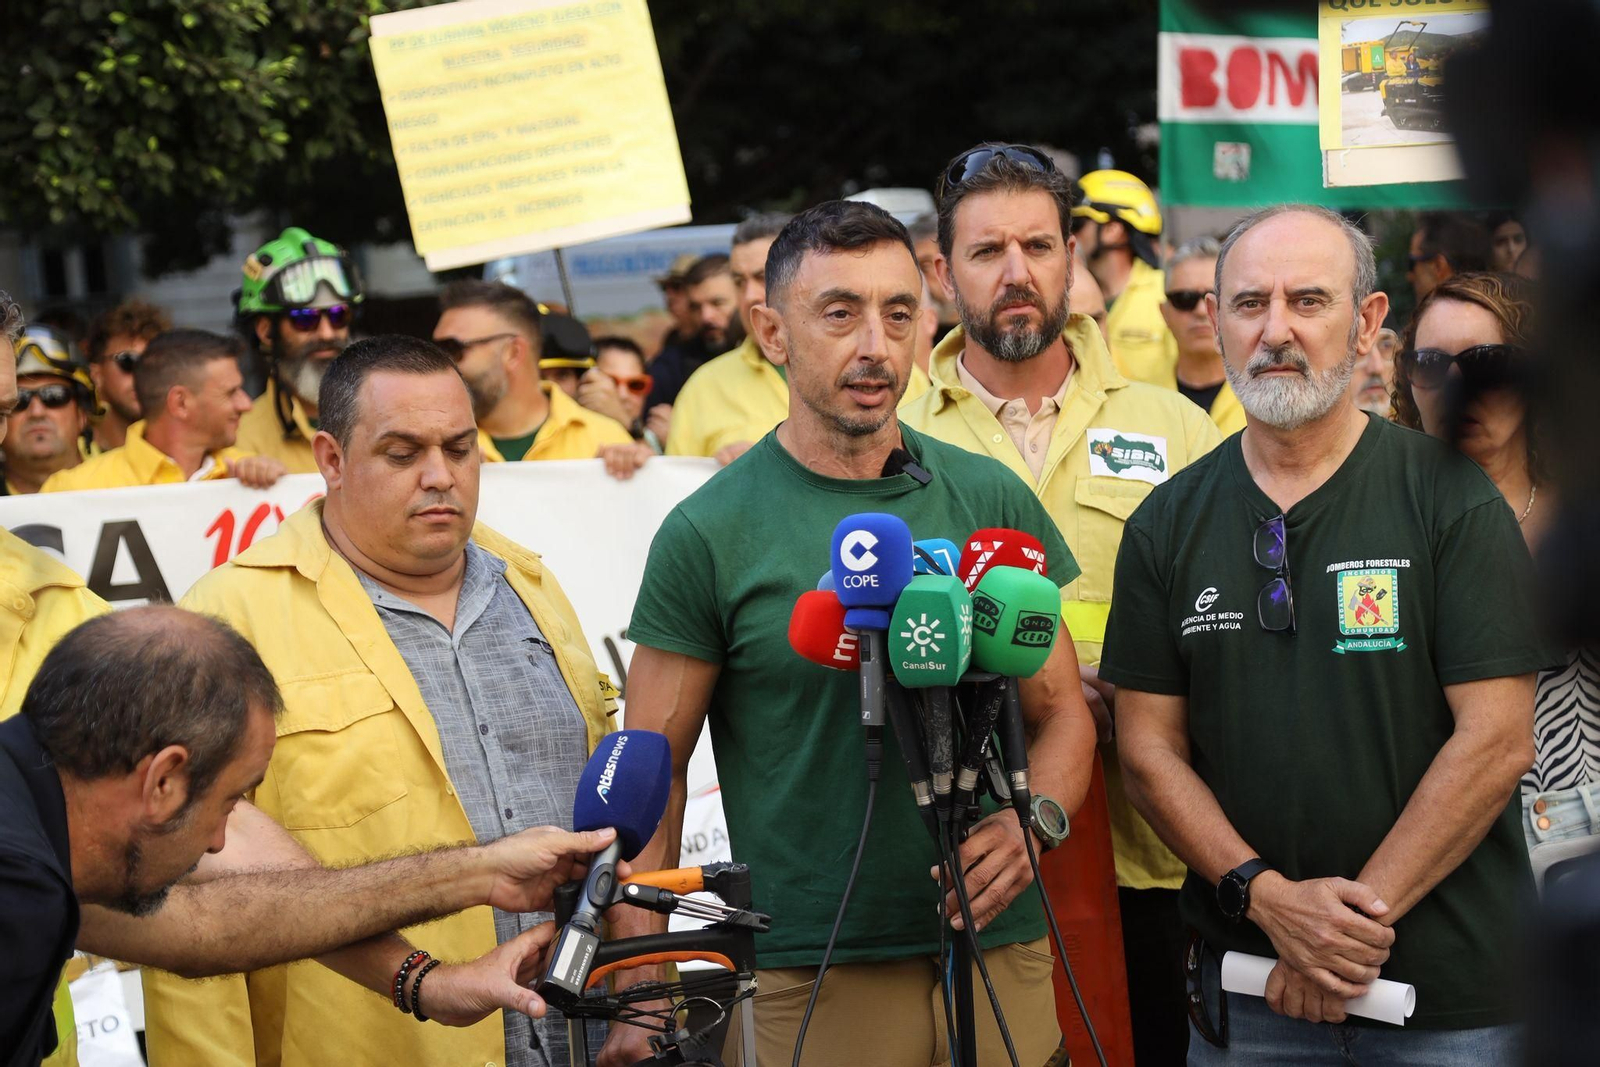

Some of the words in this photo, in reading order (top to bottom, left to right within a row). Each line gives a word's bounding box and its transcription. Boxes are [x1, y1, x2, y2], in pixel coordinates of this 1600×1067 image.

[488, 15, 547, 32] MORENO
[595, 2, 622, 14] CON
[442, 48, 502, 67] NUESTRA
[399, 79, 477, 101] DISPOSITIVO
[484, 64, 563, 87] INCOMPLETO
[568, 60, 585, 73] EN
[589, 53, 622, 69] ALTO
[391, 112, 438, 130] RIESGO
[409, 137, 449, 154] FALTA
[451, 133, 468, 147] DE
[516, 114, 580, 134] MATERIAL
[415, 149, 532, 180] COMUNICACIONES
[535, 134, 612, 158] DEFICIENTES
[497, 168, 567, 191] INEFICACES
[489, 206, 507, 220] DE
[514, 192, 584, 215] INCENDIOS
[1366, 558, 1411, 568] FORESTALES
[843, 574, 879, 589] COPE
[974, 613, 992, 627] ERO
[1024, 619, 1051, 627] ONDA
[1206, 613, 1216, 621] DE
[1218, 612, 1244, 620] MEDIO
[1212, 623, 1218, 631] Y
[1219, 622, 1241, 630] AGUA
[833, 625, 859, 661] rn
[1022, 632, 1049, 642] CERO
